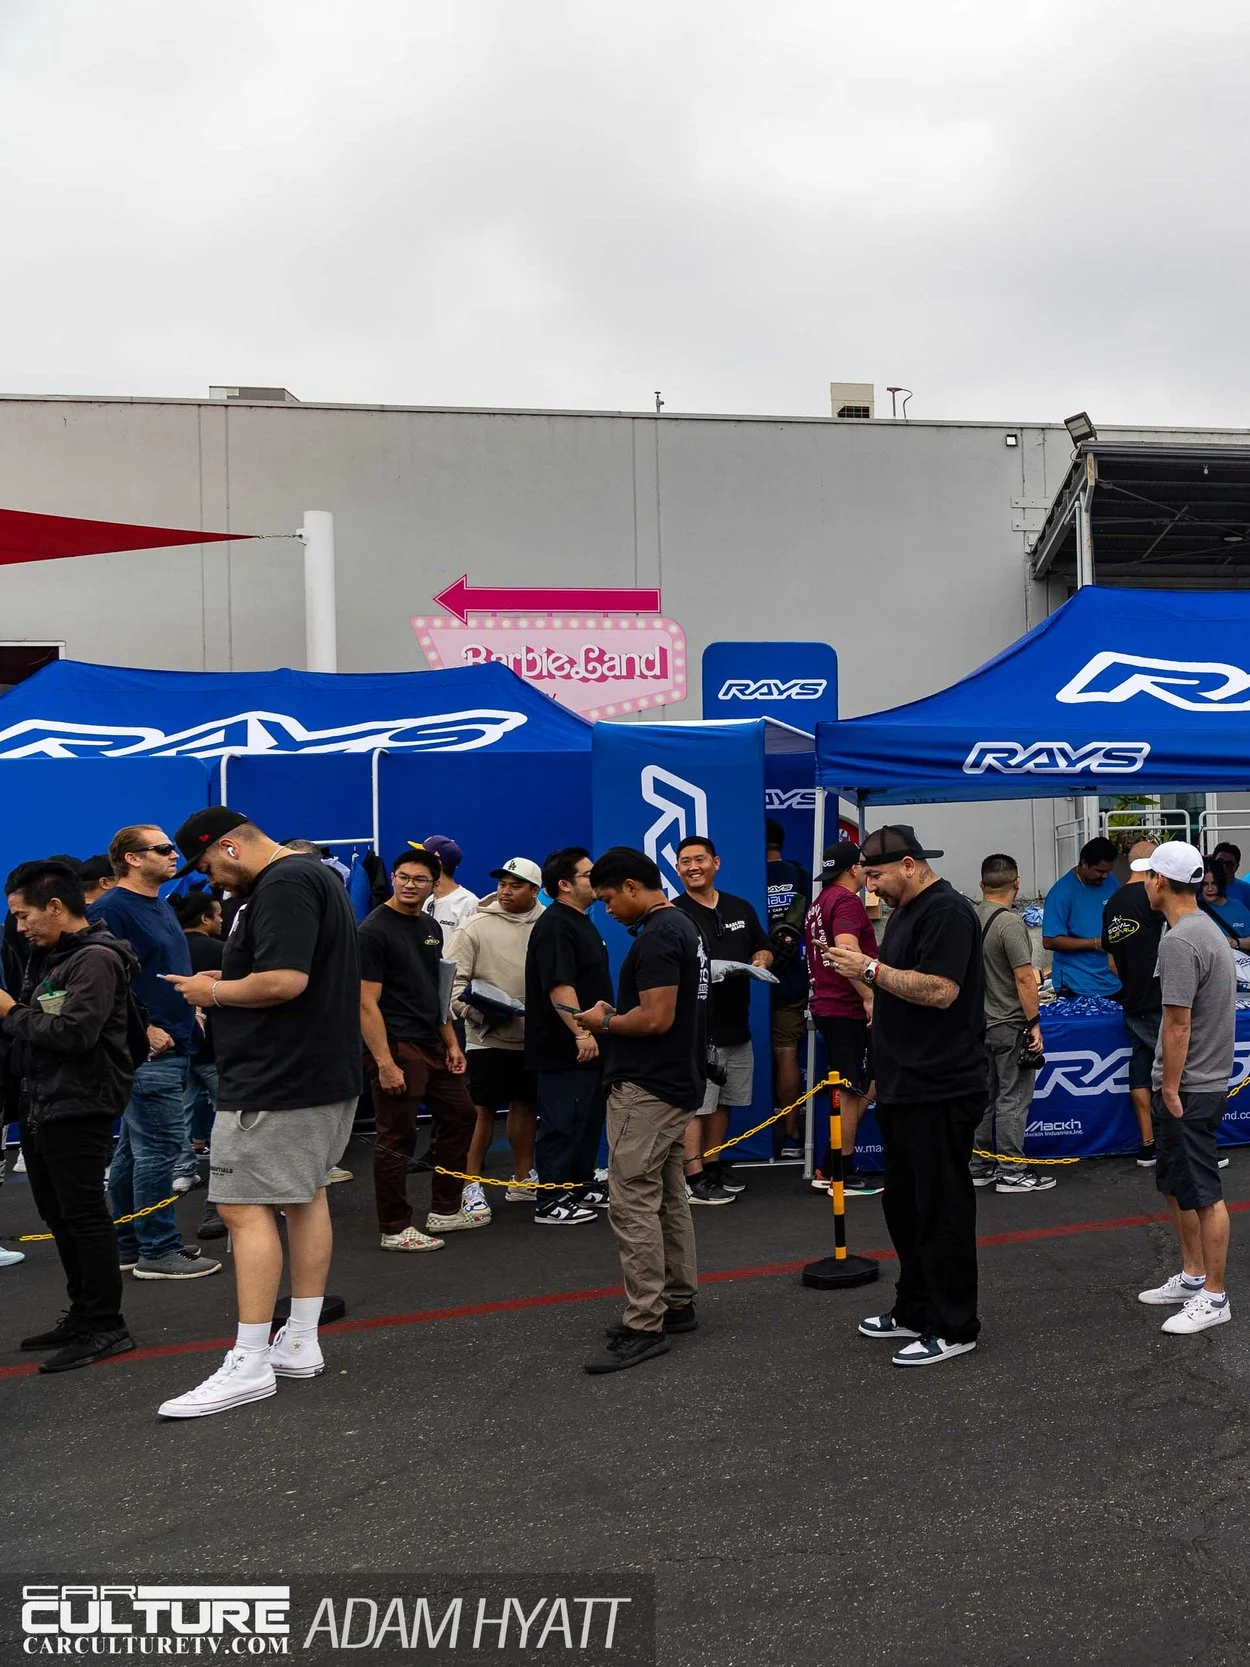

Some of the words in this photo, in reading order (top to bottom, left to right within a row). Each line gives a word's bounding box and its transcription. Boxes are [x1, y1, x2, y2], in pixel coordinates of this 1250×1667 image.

[718, 679, 826, 700] RAYS
[0, 709, 528, 758] RAYS
[962, 741, 1151, 774] RAYS
[765, 789, 828, 809] AYS
[768, 883, 793, 893] AYS
[1025, 1118, 1081, 1132] Mackin
